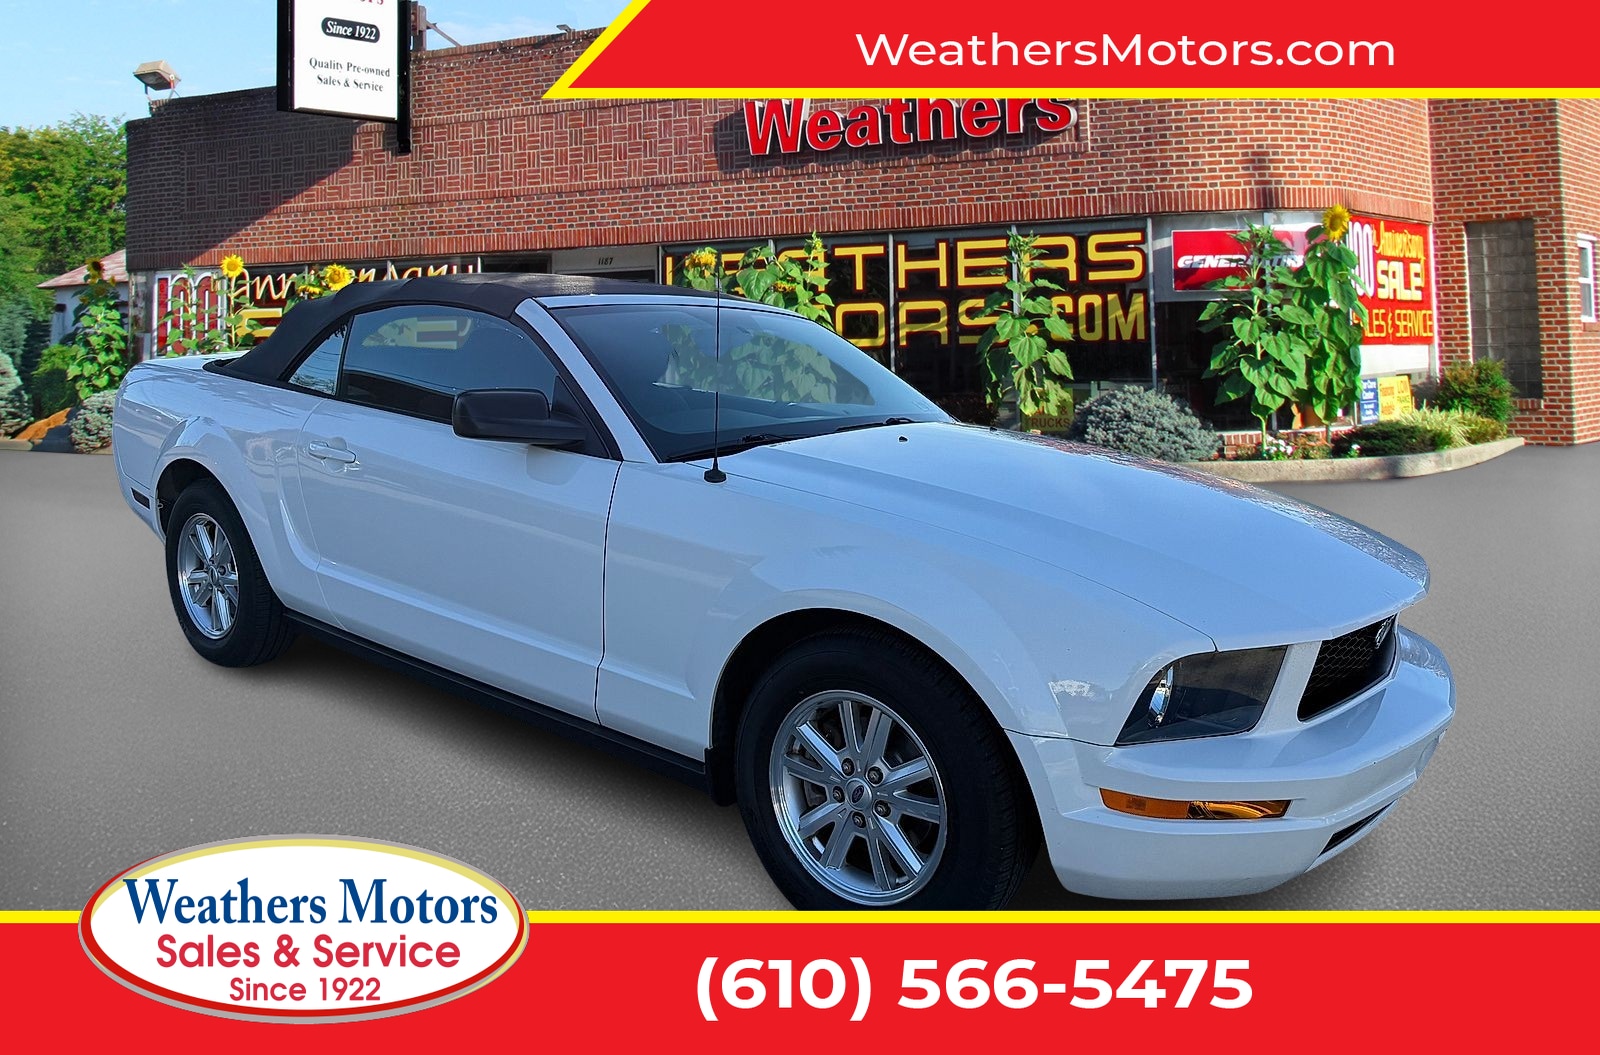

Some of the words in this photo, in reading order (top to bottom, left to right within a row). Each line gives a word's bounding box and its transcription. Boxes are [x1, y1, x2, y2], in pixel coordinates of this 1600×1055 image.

[326, 20, 353, 36] Since
[354, 25, 376, 40] 1922
[309, 57, 343, 73] Quality
[346, 62, 391, 77] Pre-owned
[316, 74, 341, 87] Sales
[343, 77, 351, 88] &
[353, 79, 384, 92] Service
[743, 98, 1077, 156] Weathers
[597, 257, 613, 266] 1187
[1376, 260, 1423, 301] SALE
[1395, 309, 1434, 337] SERVICE
